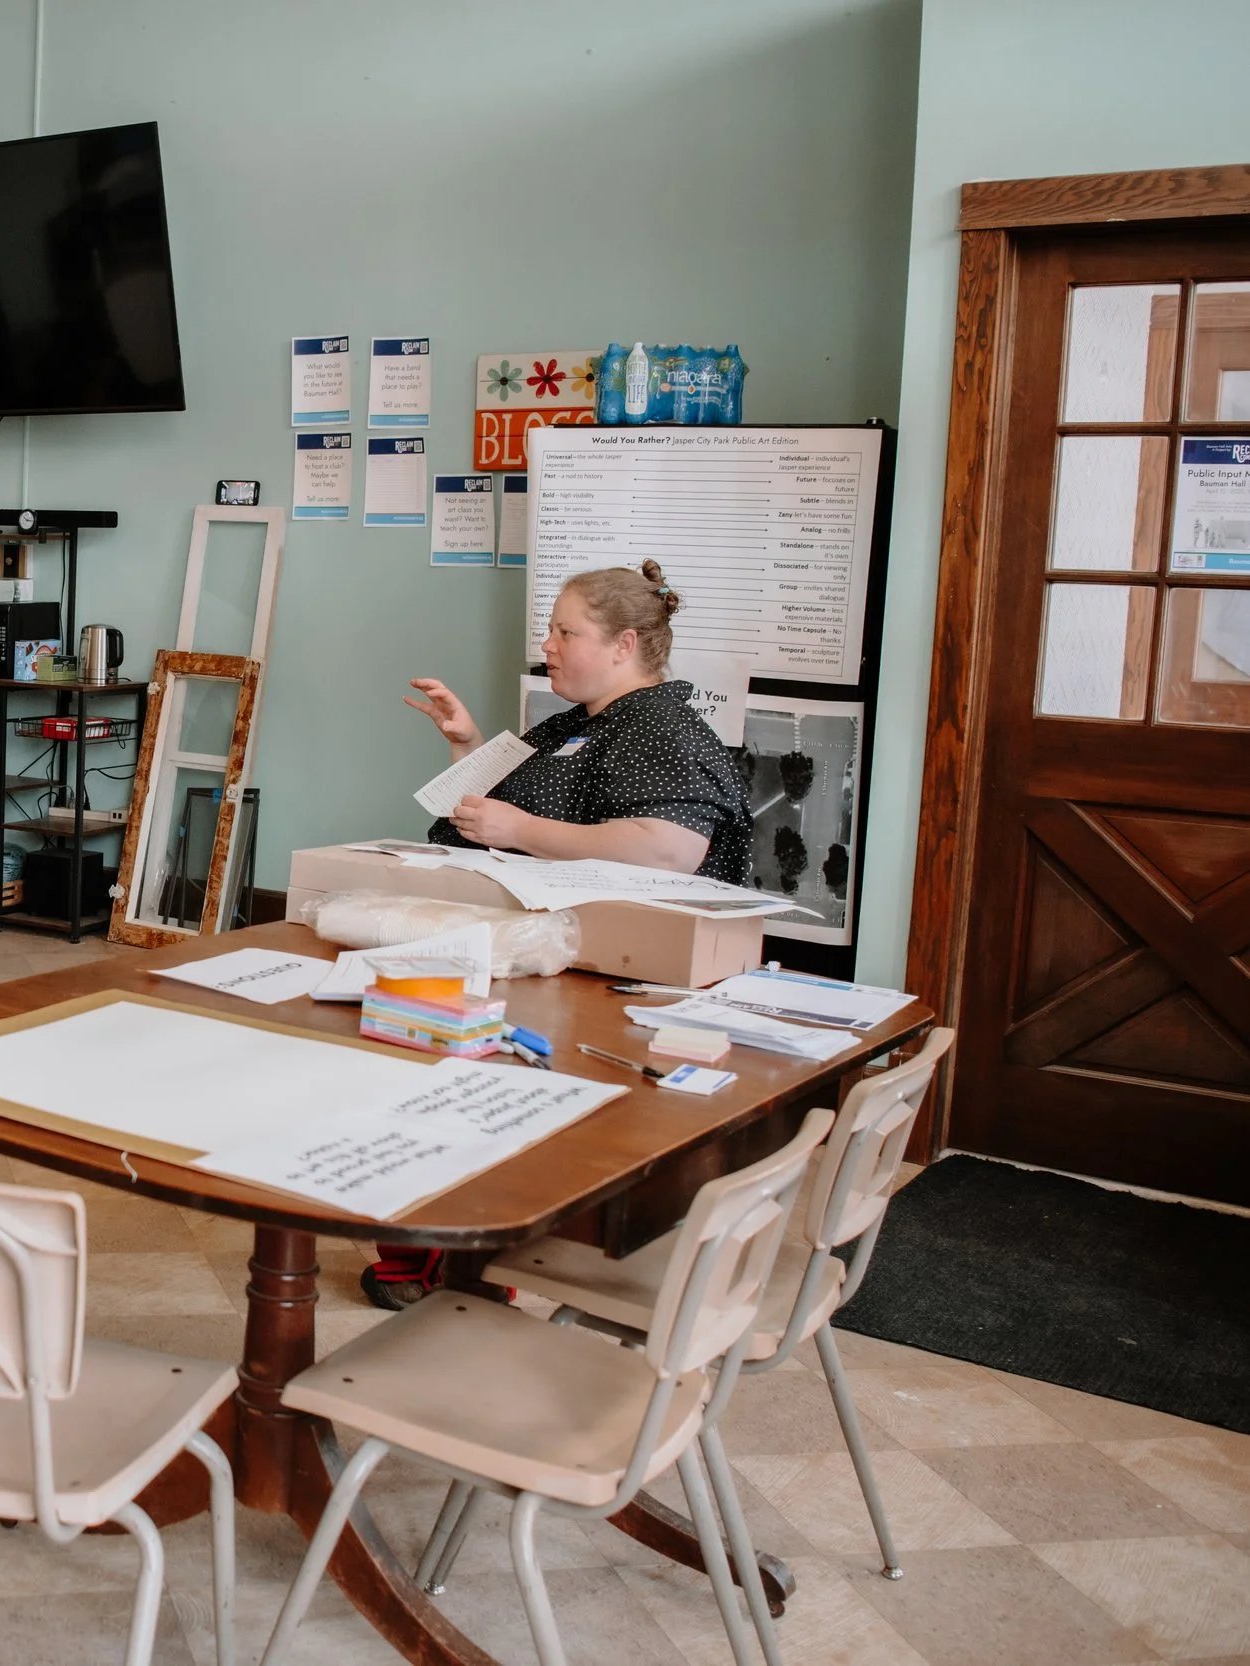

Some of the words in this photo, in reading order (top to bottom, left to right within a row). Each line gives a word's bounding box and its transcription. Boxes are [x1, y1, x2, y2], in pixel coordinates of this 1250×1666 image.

[666, 370, 722, 385] niagara
[407, 383, 422, 391] play?
[478, 411, 595, 465] BLO
[638, 436, 671, 444] Rather?
[672, 437, 695, 446] Jasper
[697, 437, 712, 446] City
[714, 437, 729, 445] Park
[733, 437, 756, 445] Public
[757, 437, 770, 445] Art
[772, 437, 799, 445] Edition
[1187, 469, 1215, 478] Public
[1218, 470, 1242, 480] Input
[444, 540, 458, 548] Sign
[705, 691, 728, 702] You
